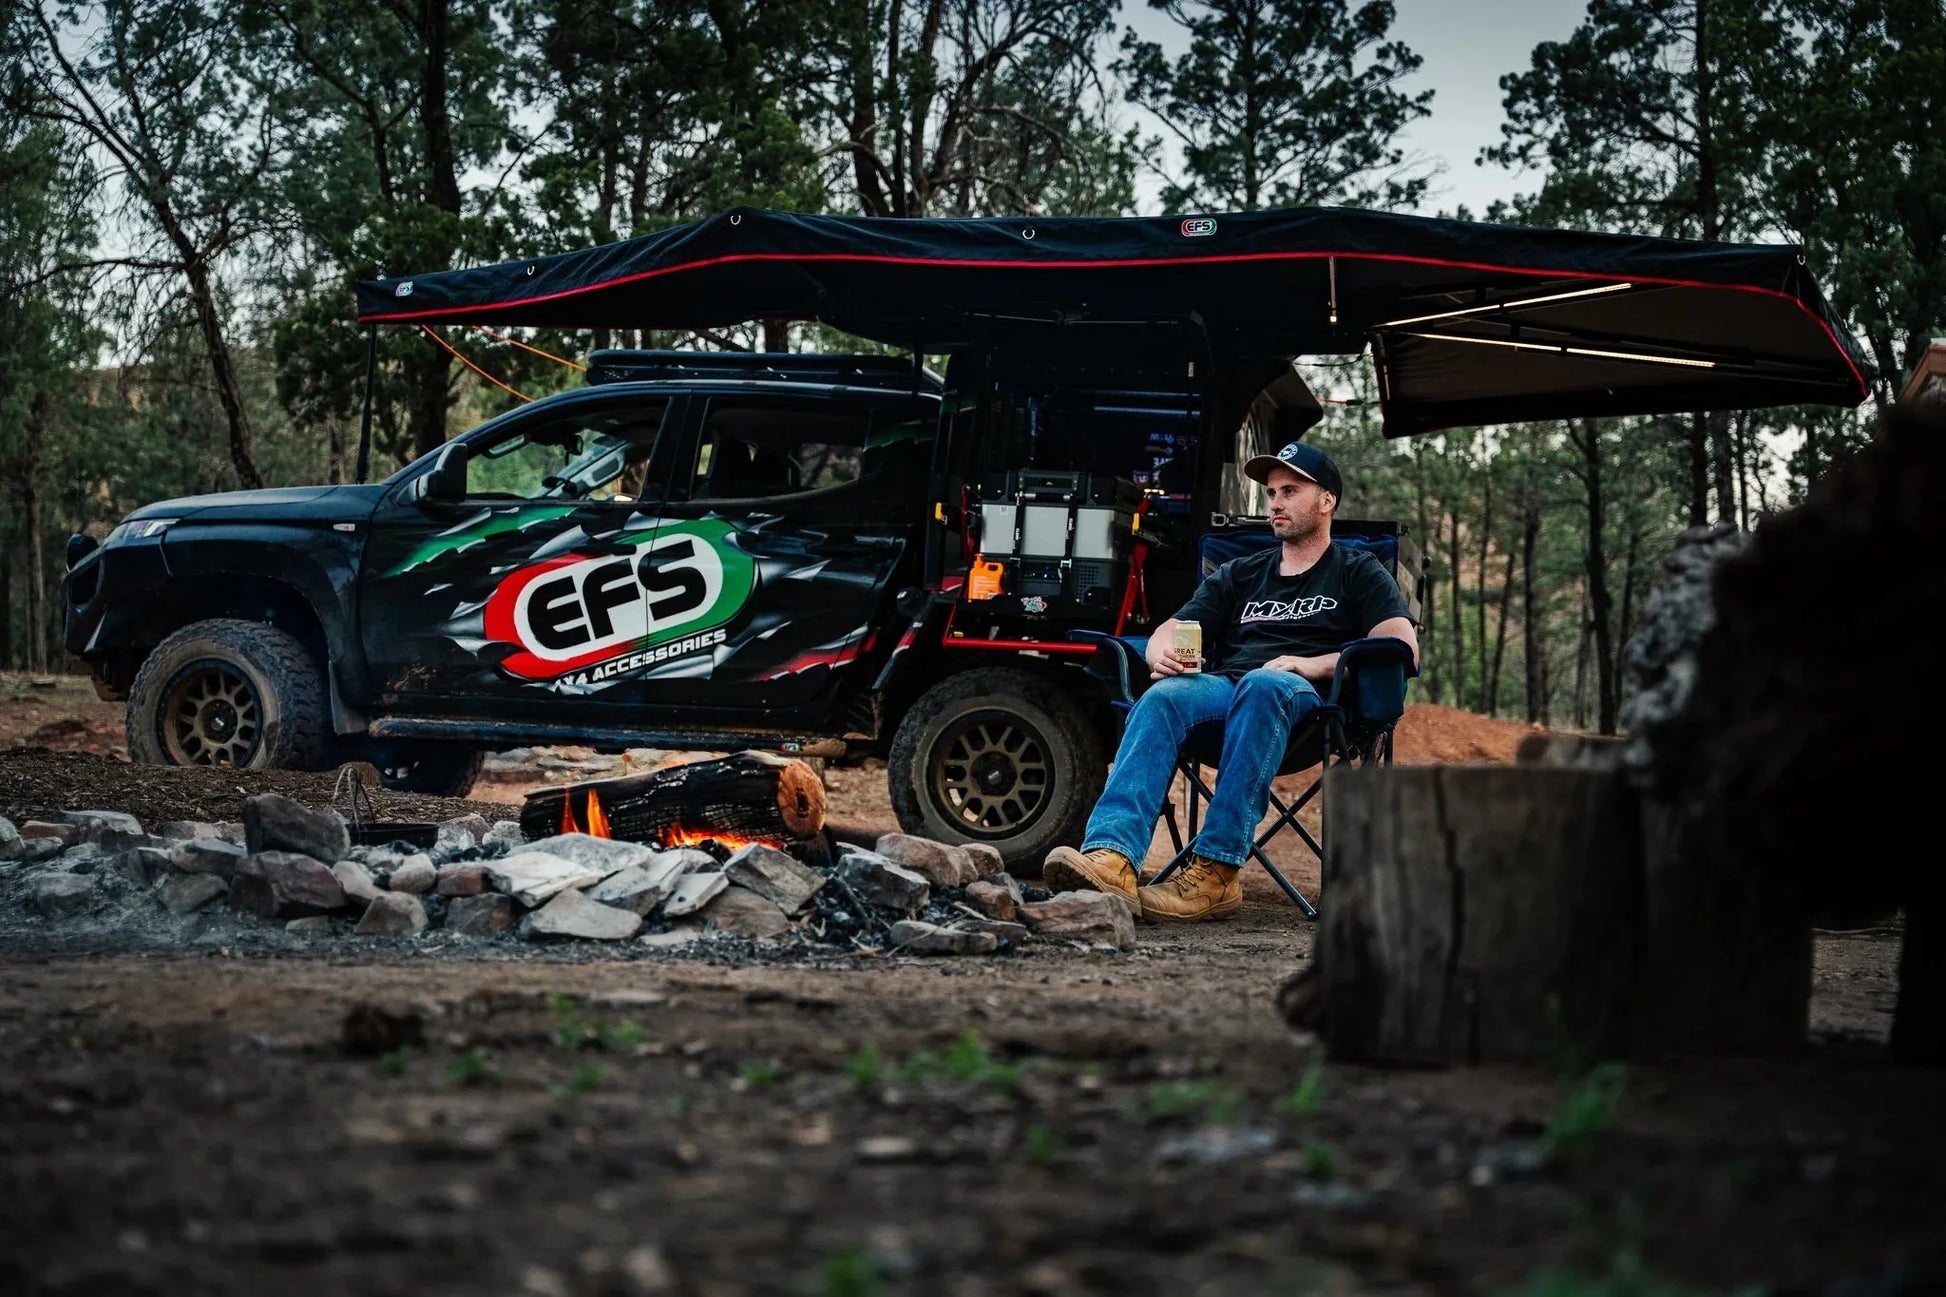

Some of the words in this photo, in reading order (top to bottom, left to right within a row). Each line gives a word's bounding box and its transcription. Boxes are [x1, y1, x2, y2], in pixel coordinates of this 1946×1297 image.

[1187, 221, 1210, 232] EFS
[527, 539, 707, 650] EFS
[592, 628, 727, 682] ACCESSORIES
